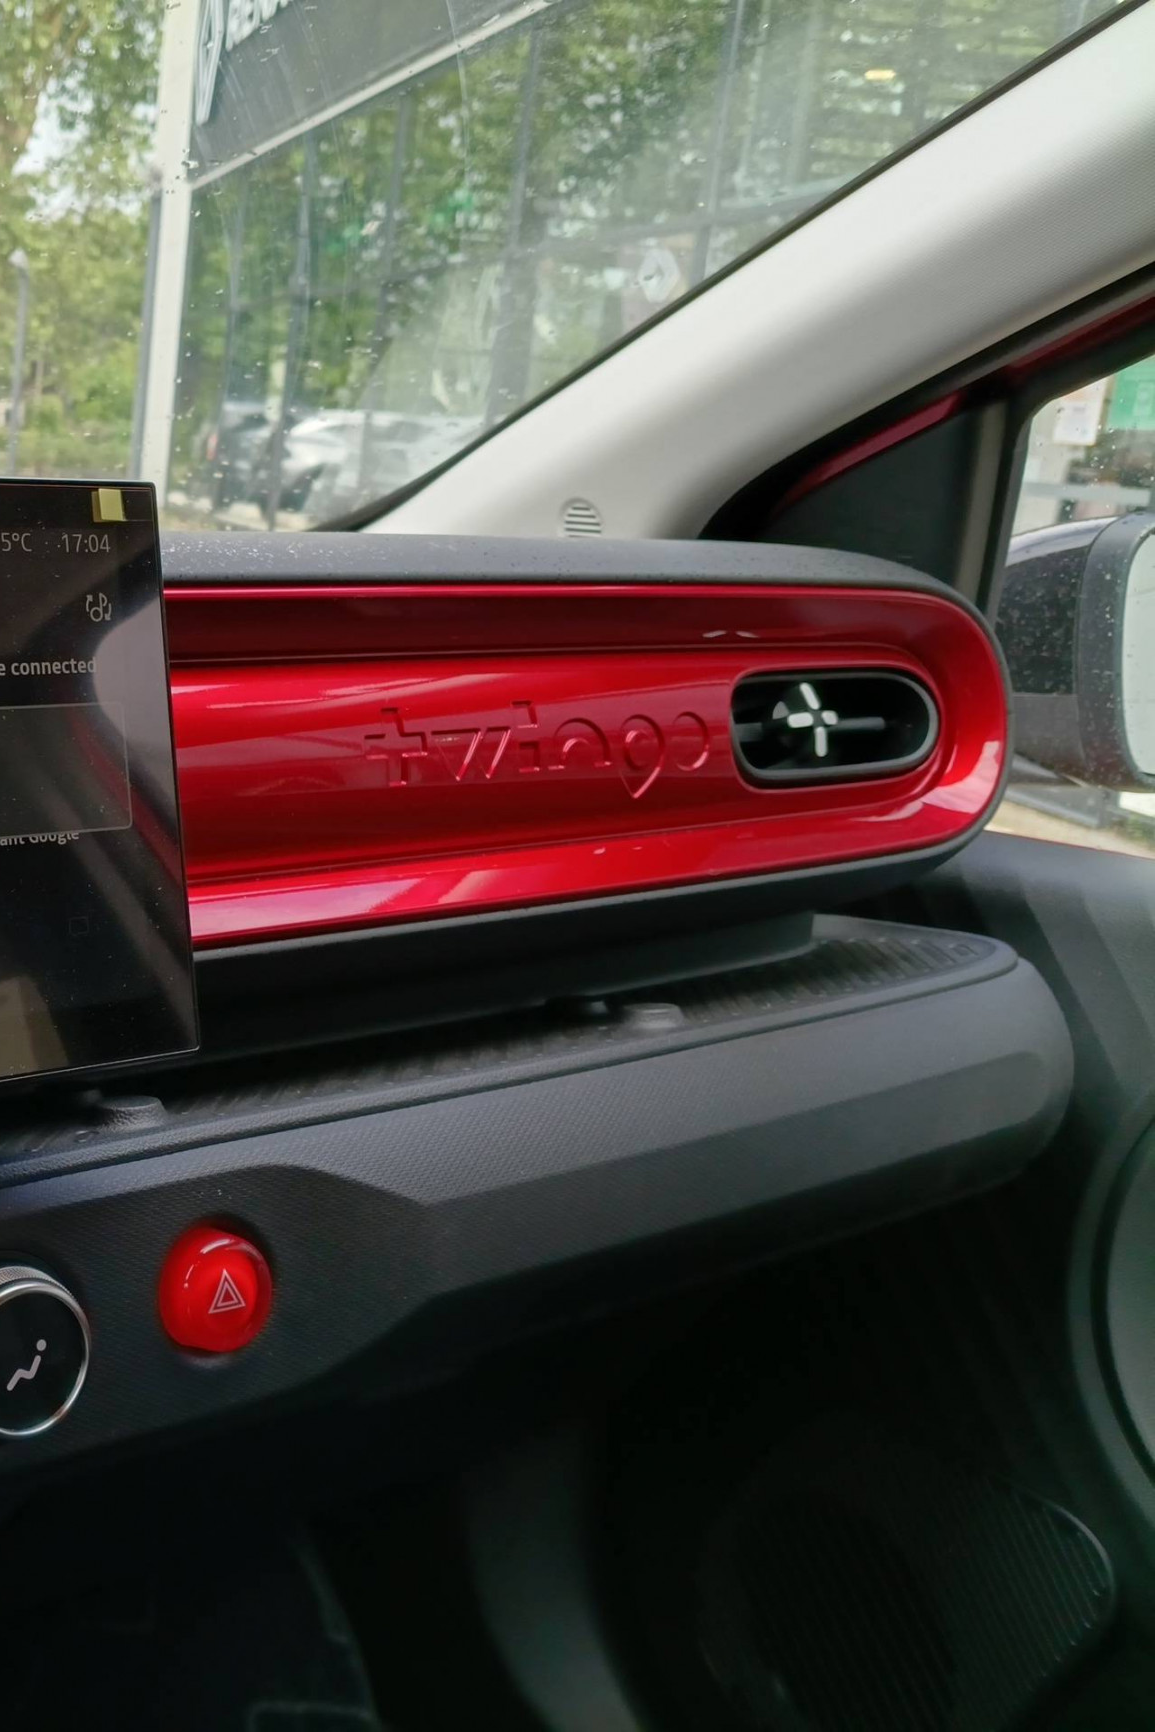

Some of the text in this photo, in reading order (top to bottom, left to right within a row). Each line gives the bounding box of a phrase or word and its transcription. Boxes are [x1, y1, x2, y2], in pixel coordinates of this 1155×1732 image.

[61, 534, 111, 553] 17:04
[10, 657, 97, 676] connected
[364, 700, 711, 800] twingo
